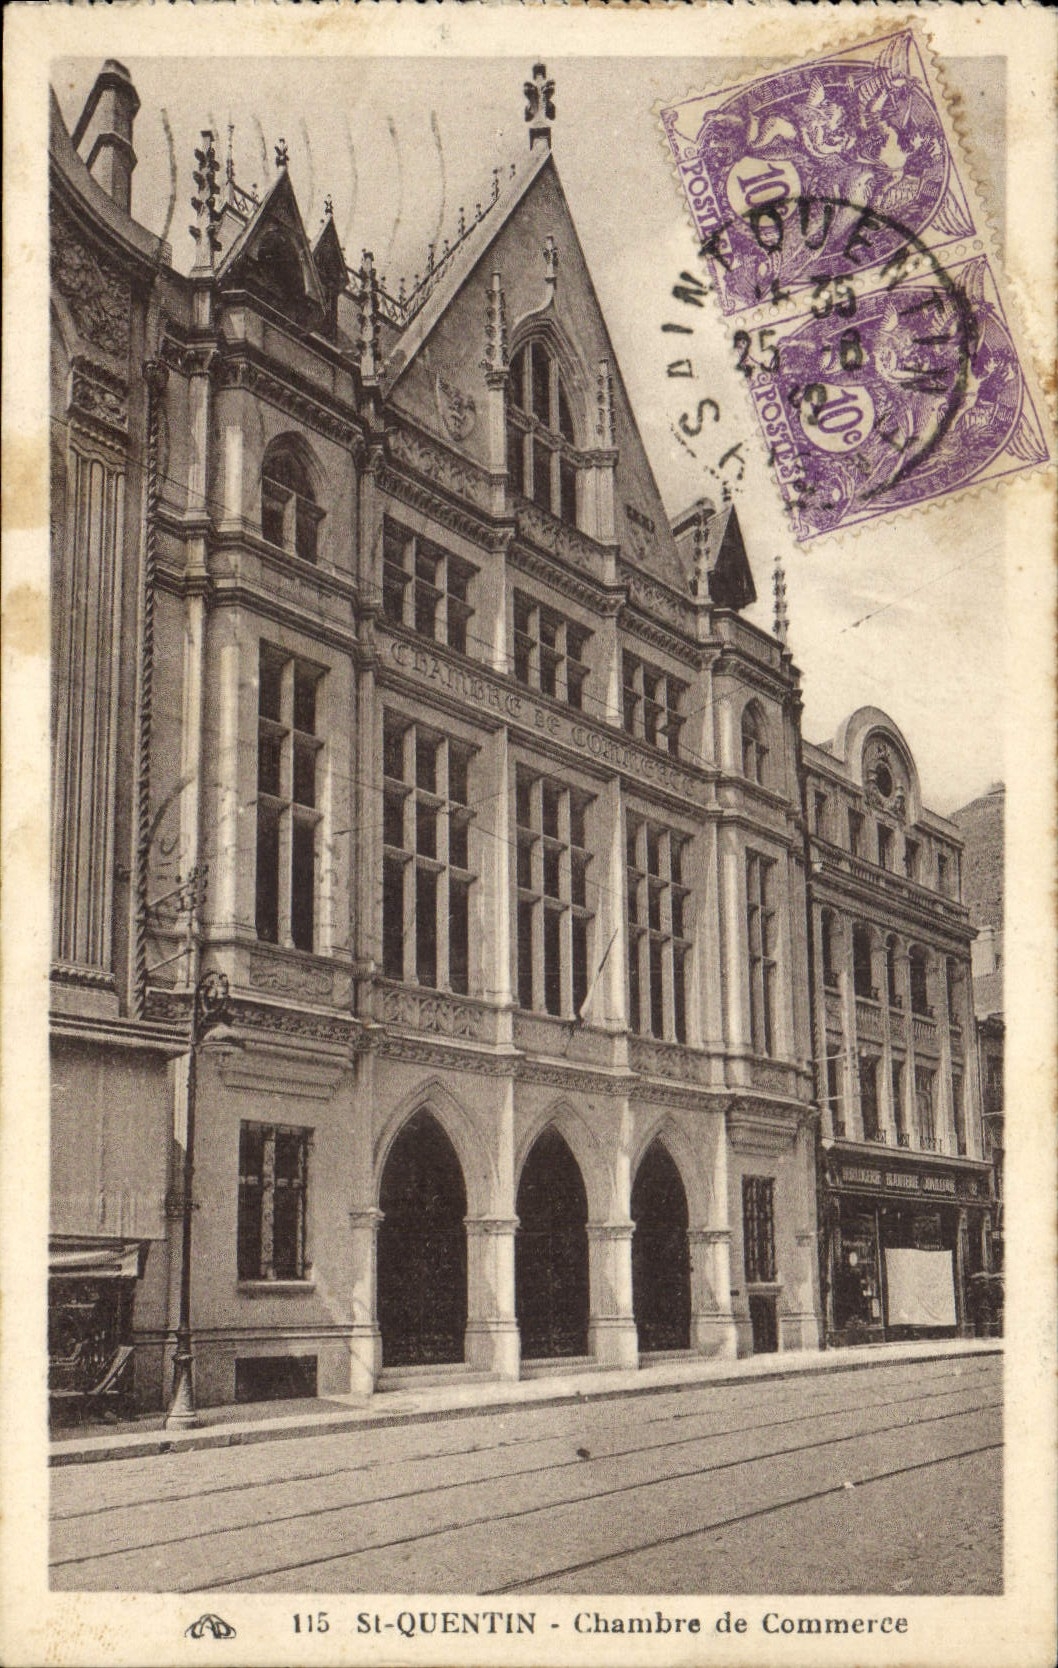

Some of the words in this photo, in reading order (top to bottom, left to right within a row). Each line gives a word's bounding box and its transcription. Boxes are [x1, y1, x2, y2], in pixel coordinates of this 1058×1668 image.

[732, 329, 781, 379] 25
[754, 385, 802, 481] POSTES
[293, 1611, 330, 1633] 115
[357, 1611, 536, 1638] St-QUENTIN
[574, 1611, 701, 1634] Chambre
[715, 1611, 748, 1634] de
[762, 1613, 908, 1634] Commerce
